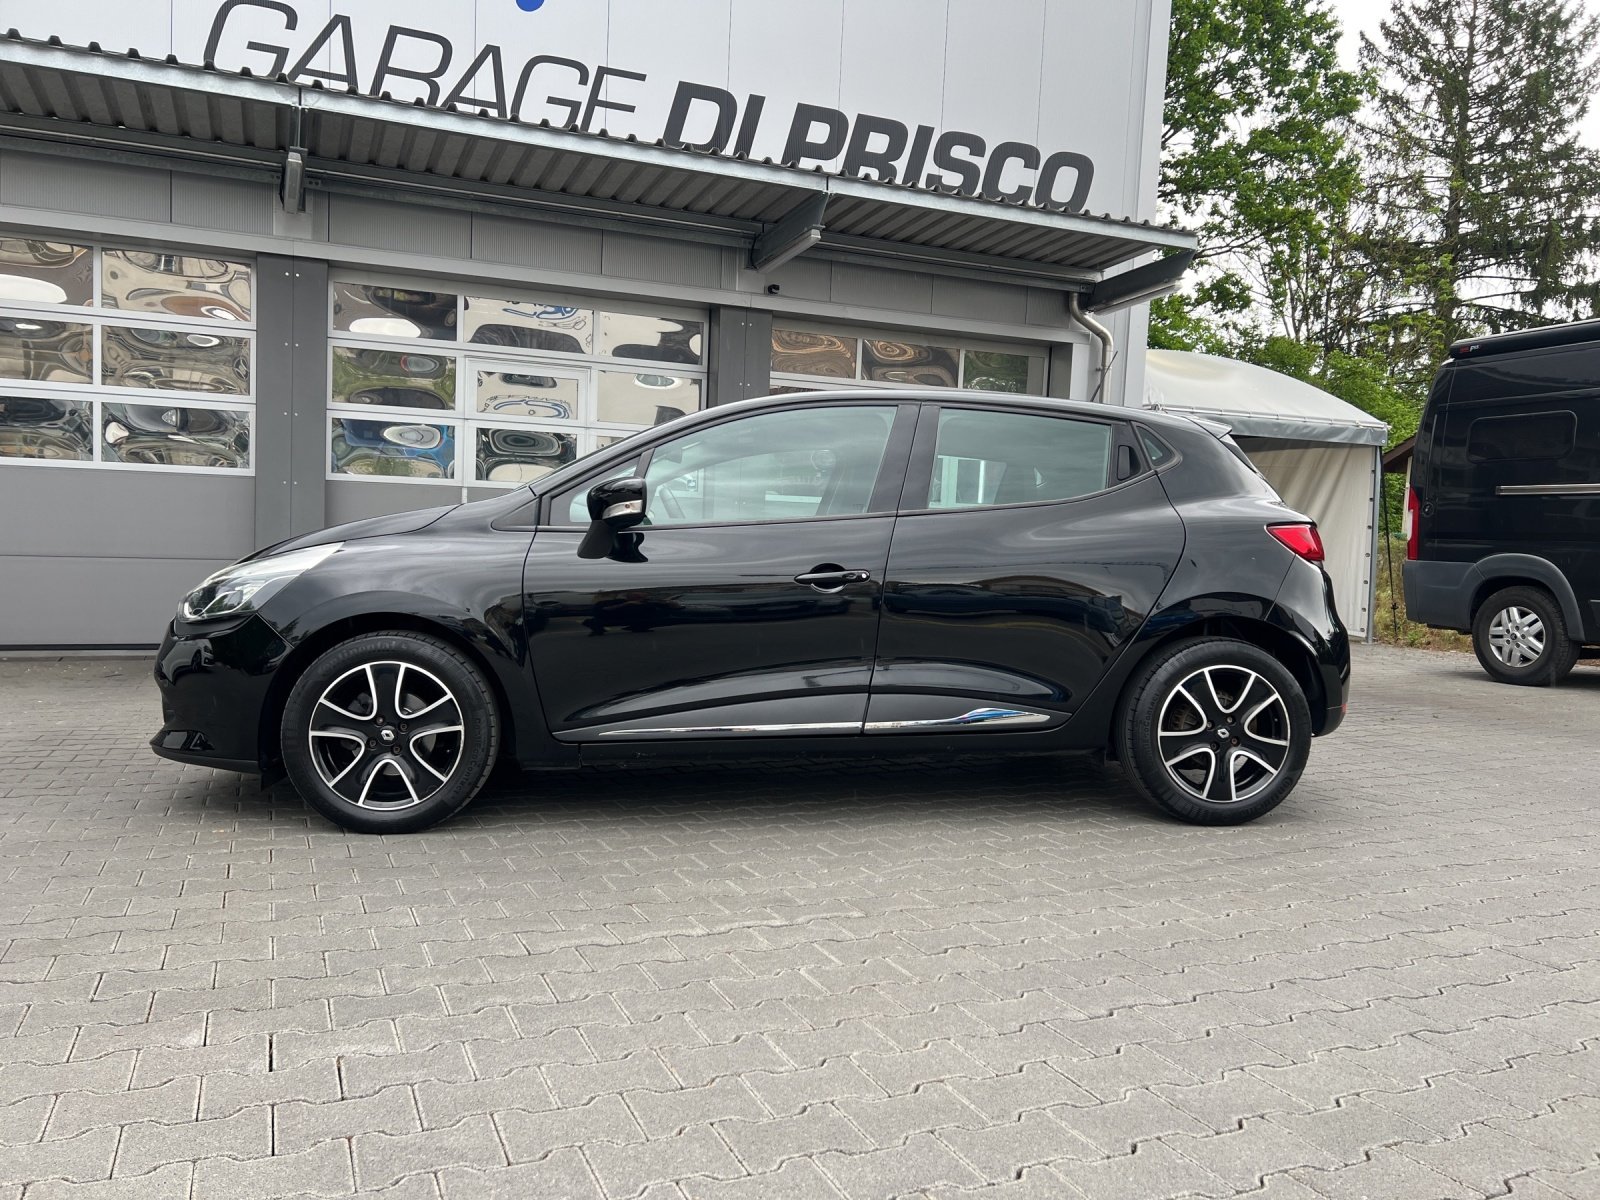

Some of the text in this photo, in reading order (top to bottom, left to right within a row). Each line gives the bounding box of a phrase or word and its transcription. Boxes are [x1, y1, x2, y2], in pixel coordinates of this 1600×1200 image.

[203, 0, 1095, 212] GARAGE DI PRISCO
